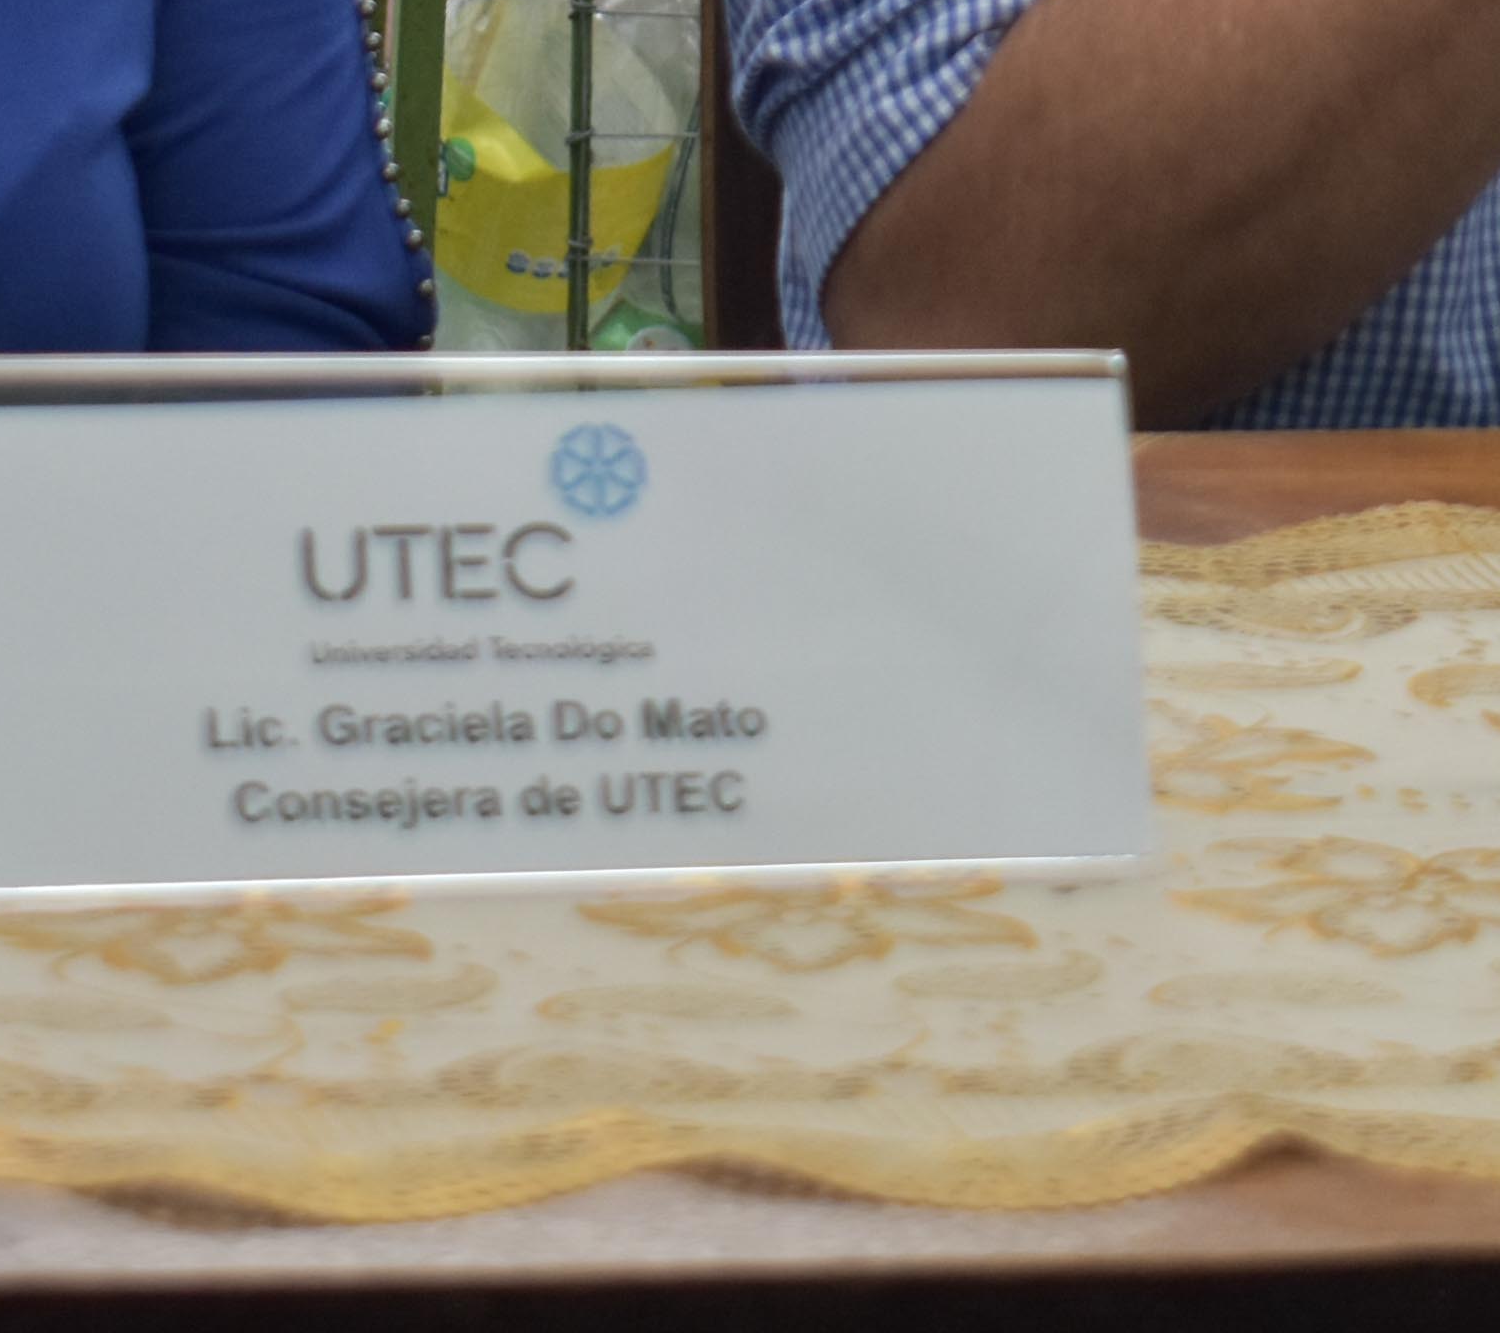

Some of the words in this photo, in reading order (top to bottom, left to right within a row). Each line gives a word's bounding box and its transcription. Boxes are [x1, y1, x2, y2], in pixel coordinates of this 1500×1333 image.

[300, 520, 578, 603] UTEC
[205, 705, 300, 750] Lic.
[318, 699, 537, 746] Graciela
[552, 697, 626, 744] Do
[640, 696, 769, 741] Mato
[234, 776, 503, 831] Consejera
[518, 773, 582, 818] de
[599, 769, 747, 816] UTEC
